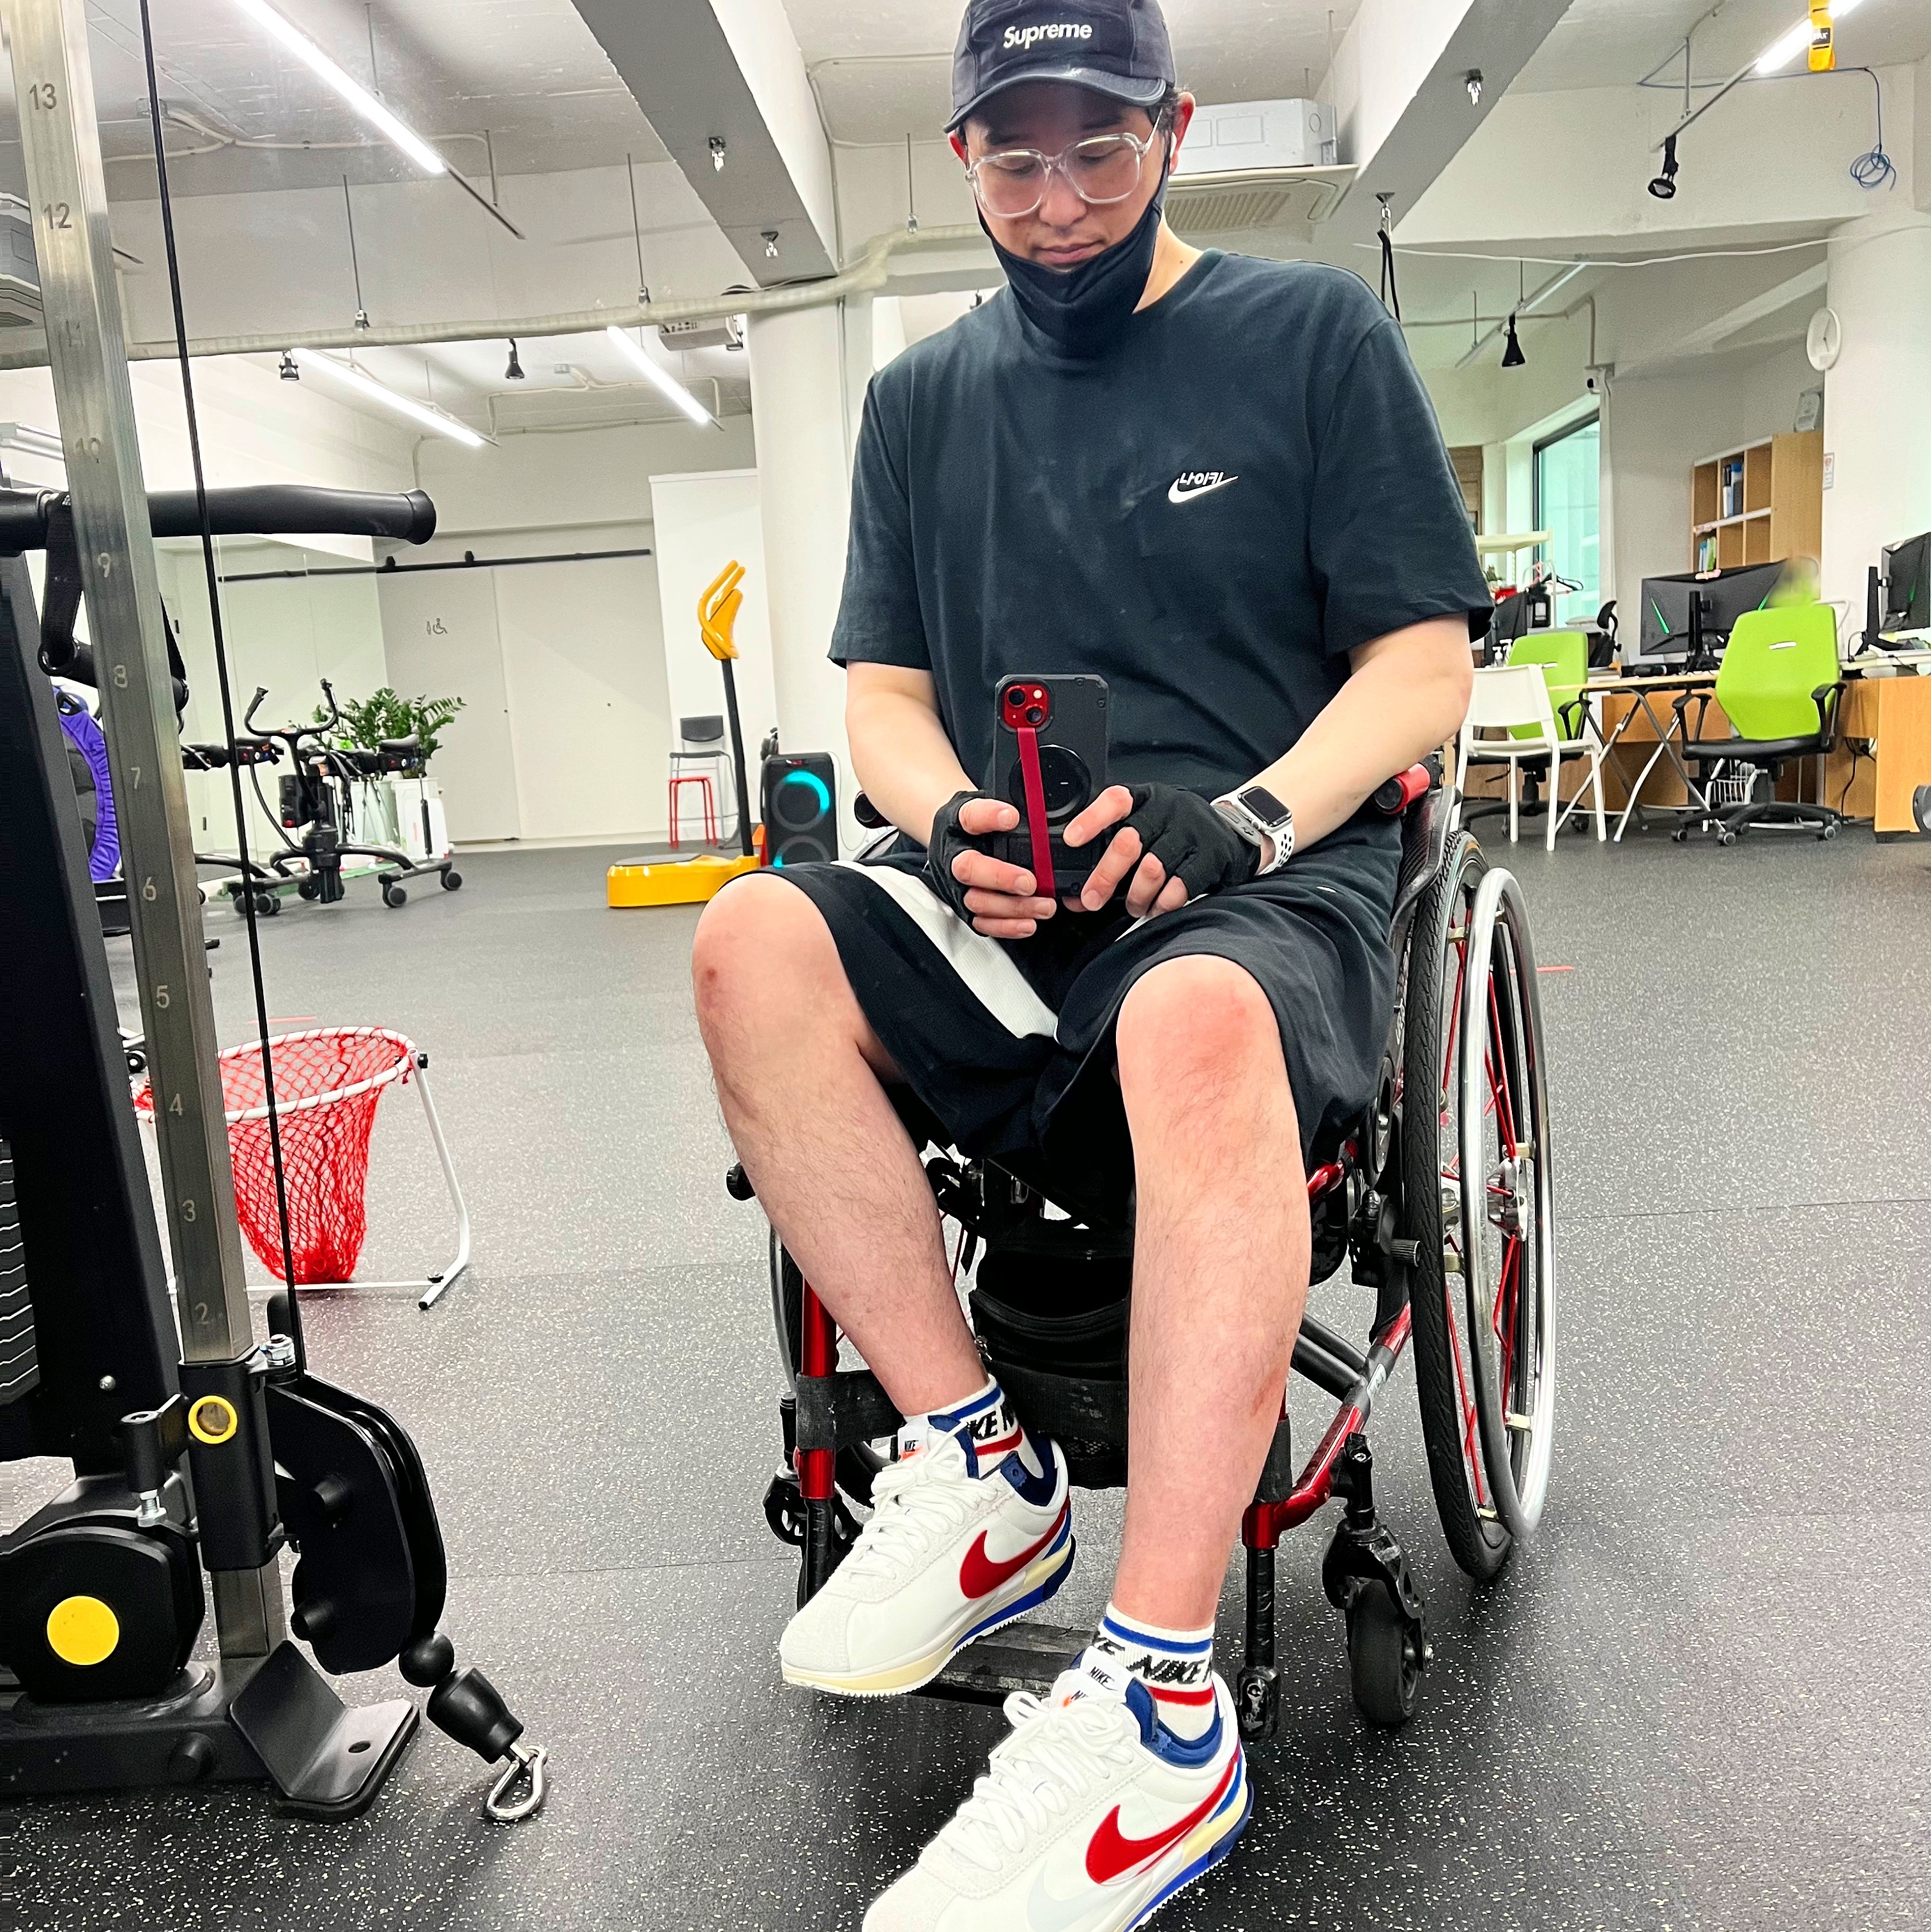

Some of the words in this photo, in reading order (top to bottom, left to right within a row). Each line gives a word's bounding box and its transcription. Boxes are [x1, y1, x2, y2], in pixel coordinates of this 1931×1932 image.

[1003, 24, 1092, 49] Supreme
[29, 82, 57, 110] 13
[43, 202, 72, 229] 12
[1179, 471, 1225, 486] 나이키
[96, 552, 111, 578] 9
[114, 664, 128, 688] 8
[130, 767, 141, 790] 7
[142, 876, 157, 901] 6
[156, 985, 170, 1009] 5
[169, 1092, 183, 1116] 4
[182, 1199, 196, 1222] 3
[195, 1302, 210, 1324] 2
[1088, 1666, 1115, 1687] NIKE
